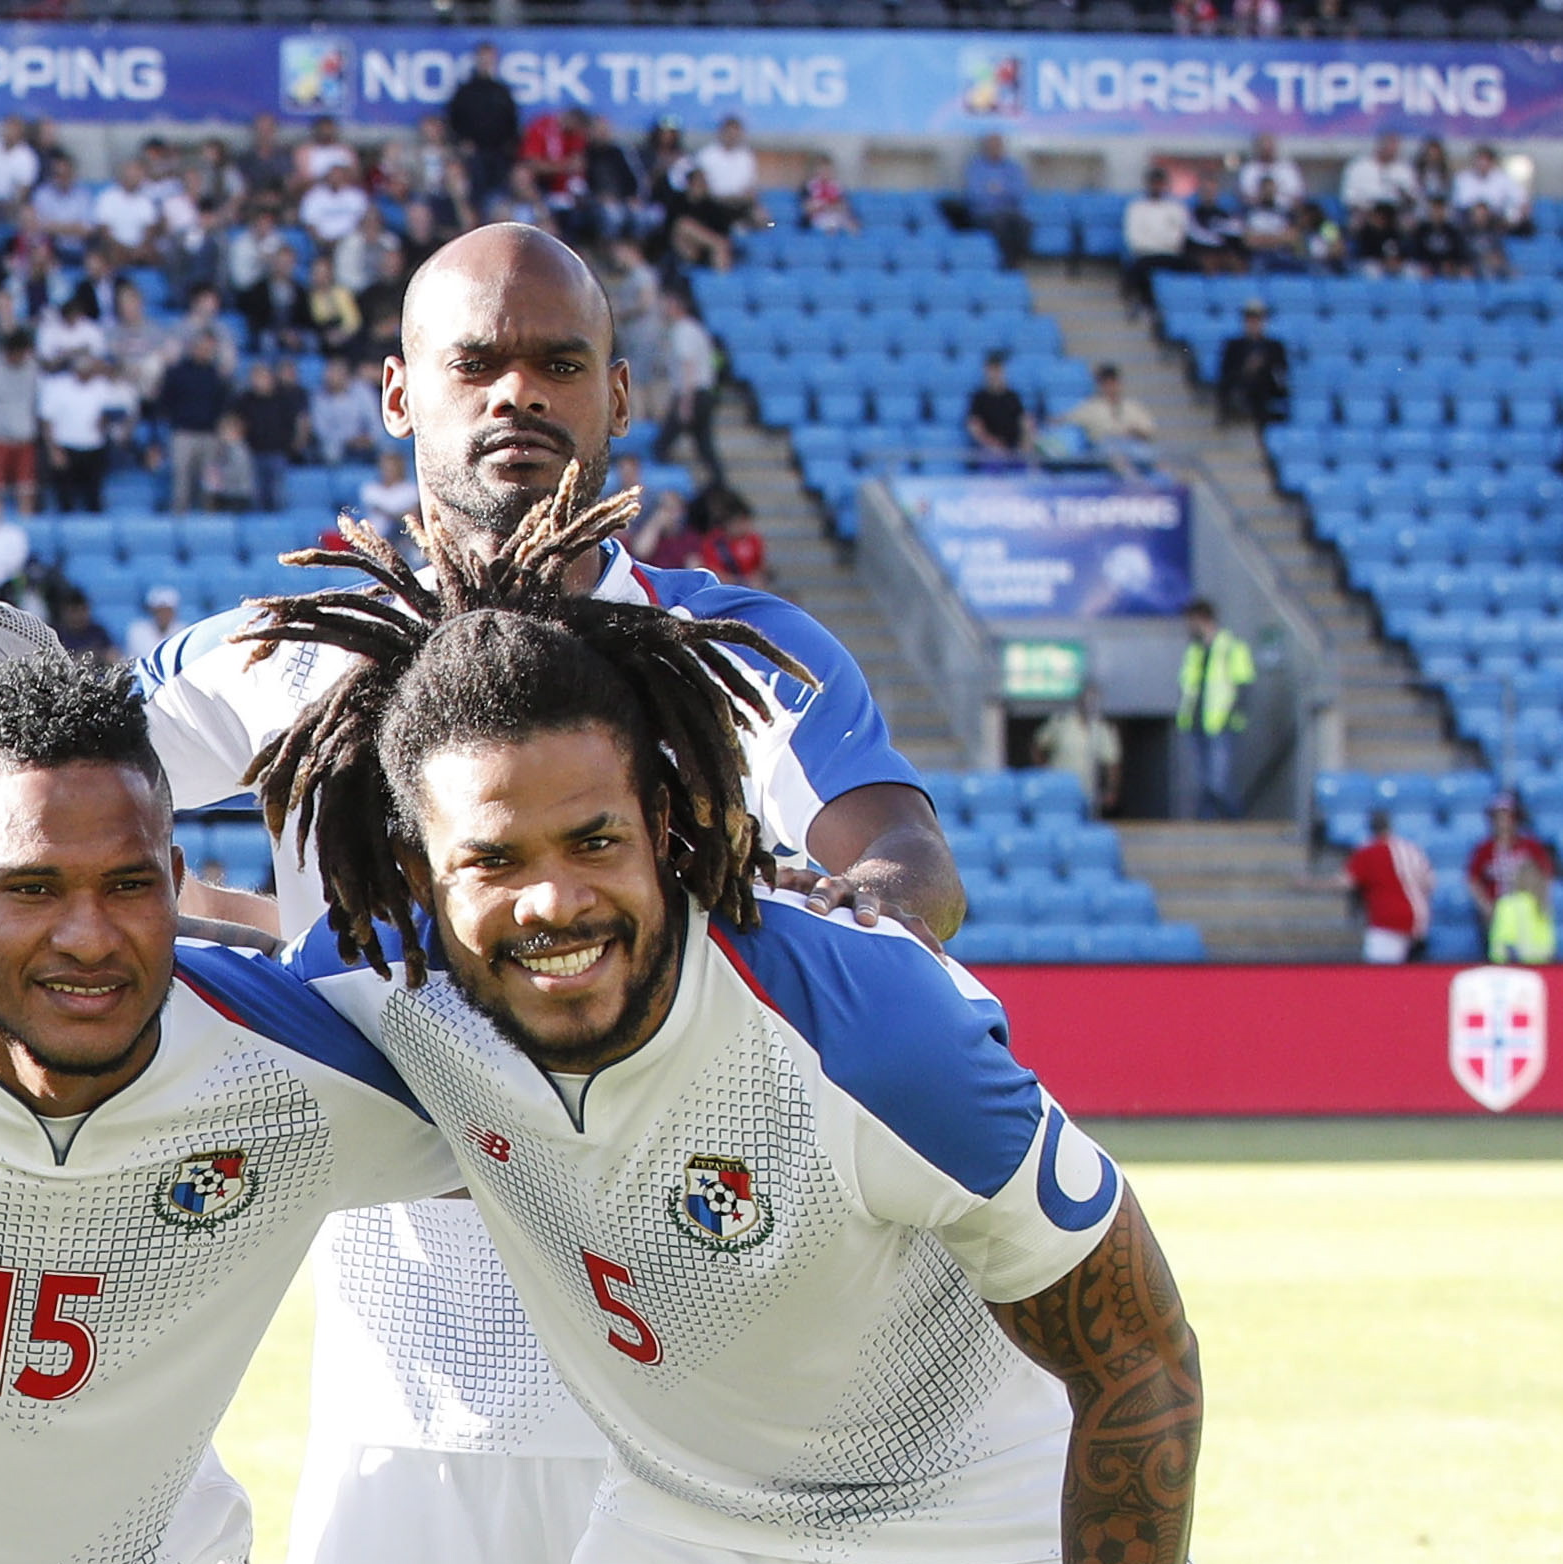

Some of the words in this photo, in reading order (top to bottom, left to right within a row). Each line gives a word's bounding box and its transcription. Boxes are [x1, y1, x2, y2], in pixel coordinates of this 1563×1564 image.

[362, 50, 594, 104] NOSK
[597, 53, 847, 107] TIPPING
[1037, 58, 1258, 114] NORSK
[1263, 60, 1506, 118] TIPPING
[463, 1120, 511, 1163] NB
[582, 1247, 664, 1367] 5
